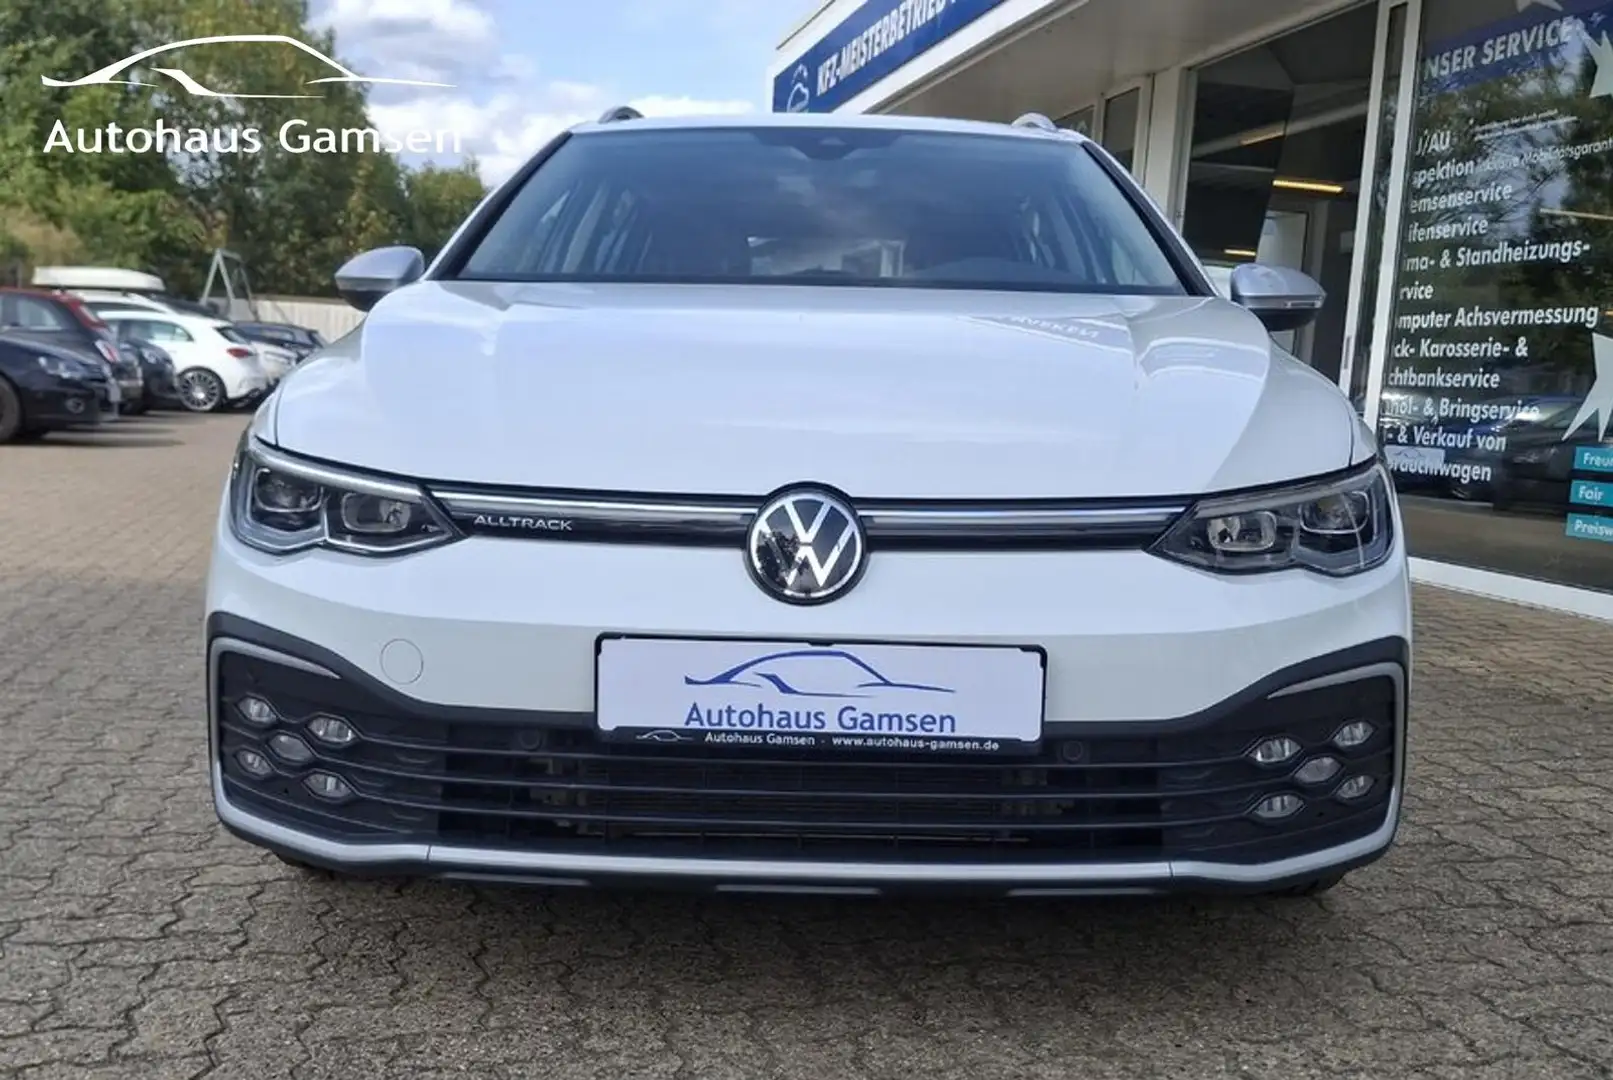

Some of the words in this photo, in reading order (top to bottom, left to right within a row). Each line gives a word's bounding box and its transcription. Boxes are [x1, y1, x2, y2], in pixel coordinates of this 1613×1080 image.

[1481, 15, 1572, 65] SERVICE
[1440, 249, 1452, 268] &
[1456, 239, 1590, 267] Standheizungs-
[1396, 310, 1451, 333] mputer
[1454, 304, 1598, 329] Achsvermessung
[1420, 336, 1509, 358] Karosserie-
[1515, 336, 1528, 357] &
[1424, 398, 1435, 416] &
[1439, 398, 1540, 423] Bringservice
[1398, 425, 1408, 443] &
[1414, 425, 1473, 448] Verkauf
[1477, 434, 1507, 451] von
[1579, 485, 1604, 502] Fair
[473, 514, 572, 532] ALLTRACK
[684, 702, 827, 730] Autohaus
[837, 706, 956, 733] Gamsen
[704, 731, 763, 744] Autohaus
[766, 733, 816, 746] Gamsen
[832, 734, 1000, 752] www.autohaus-gamsen.de
